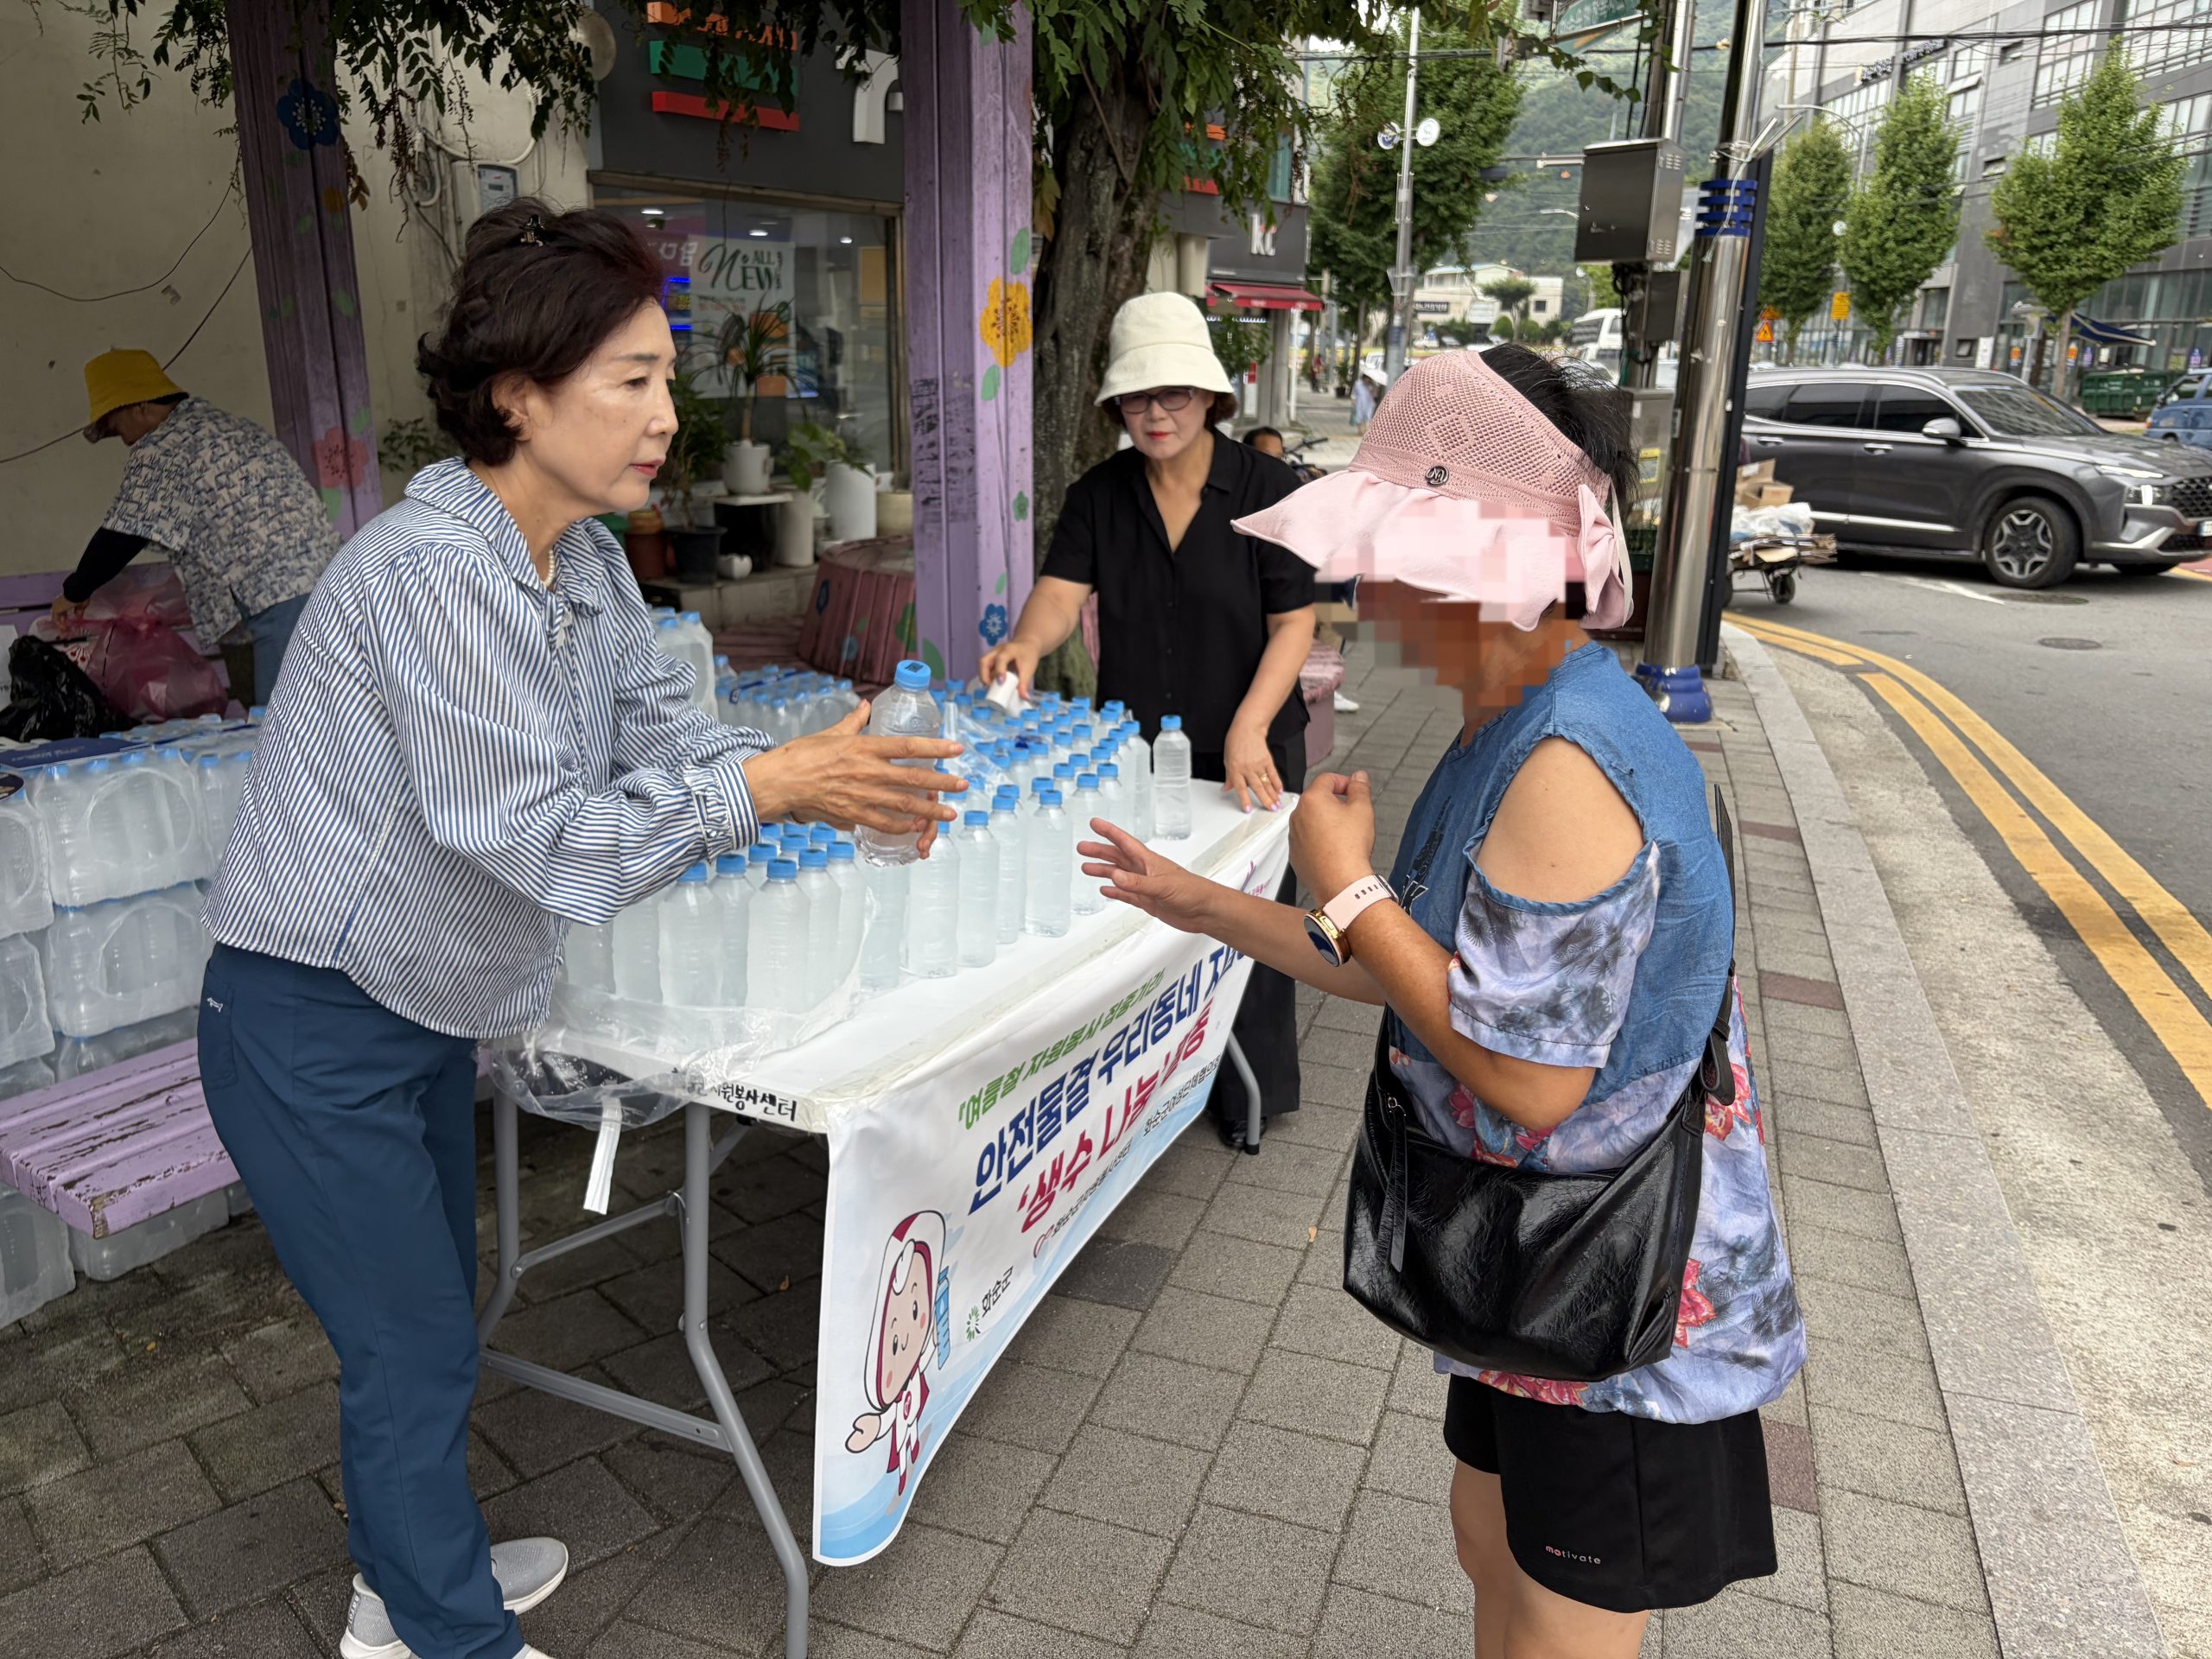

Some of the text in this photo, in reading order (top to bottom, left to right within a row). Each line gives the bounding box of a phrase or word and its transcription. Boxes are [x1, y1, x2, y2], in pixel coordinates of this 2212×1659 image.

[1022, 1013, 1104, 1082] 자원봉사
[968, 1047, 1101, 1217] 안전물결
[1097, 958, 1204, 1086] 우리동네
[982, 1266, 1014, 1318] 화순군
[1545, 1545, 1602, 1565] motivate
